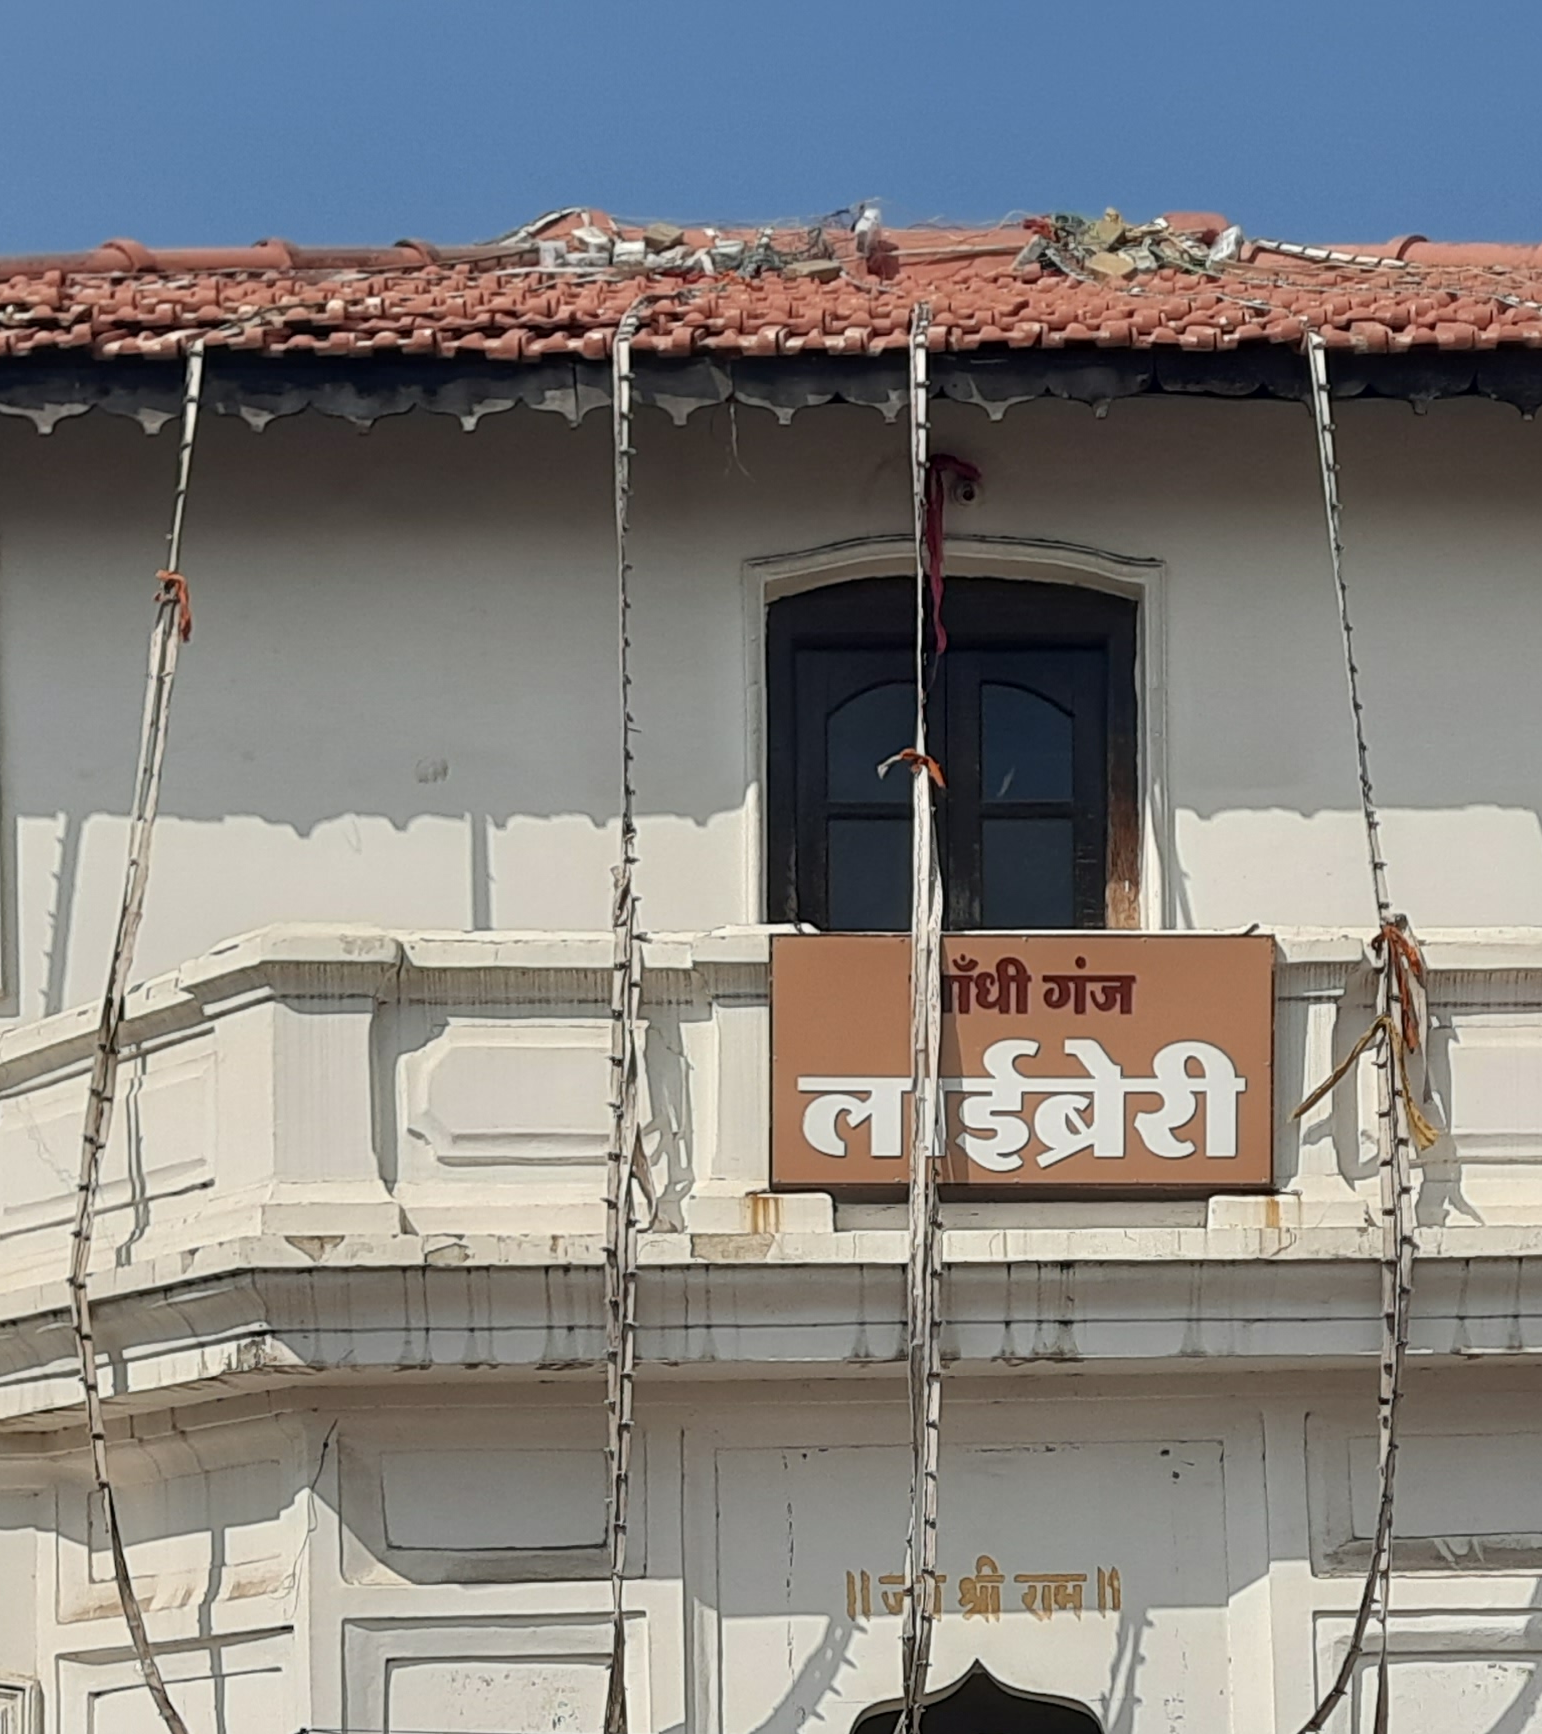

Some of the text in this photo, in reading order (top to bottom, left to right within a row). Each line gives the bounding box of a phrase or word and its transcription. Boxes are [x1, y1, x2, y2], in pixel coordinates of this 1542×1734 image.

[1042, 954, 1137, 1015] गंज
[797, 1038, 1247, 1172] लाईब्रेरी
[959, 1555, 1005, 1623] श्री
[1014, 1573, 1088, 1623] राम
